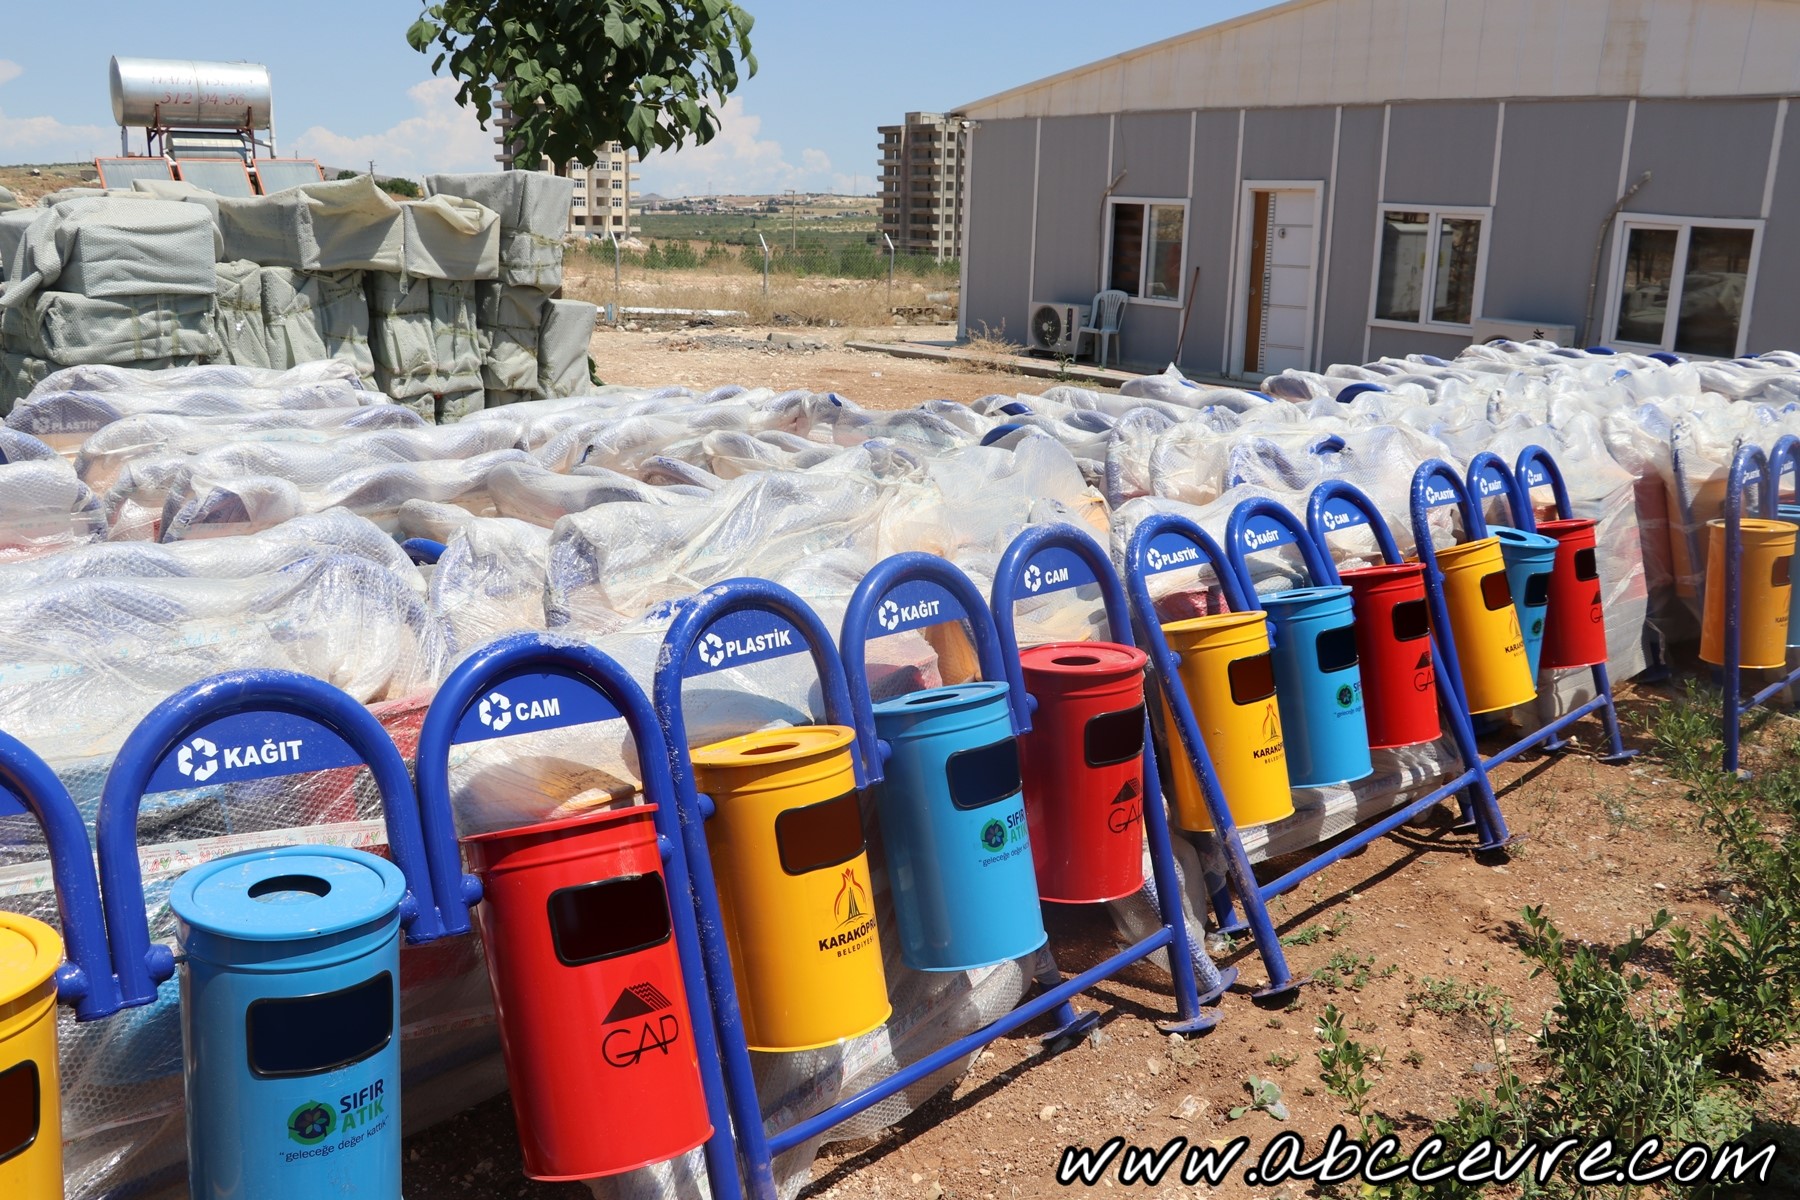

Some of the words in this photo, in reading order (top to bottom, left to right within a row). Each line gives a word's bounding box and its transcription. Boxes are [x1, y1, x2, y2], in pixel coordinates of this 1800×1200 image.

[1433, 488, 1456, 501] PLASTİK
[1334, 512, 1350, 525] CAM
[1256, 529, 1279, 545] KAĞIT
[1162, 546, 1199, 566] PLASTİK
[1045, 567, 1069, 585] CAM
[901, 600, 940, 622] KAĞIT
[726, 628, 792, 658] PLASTİK
[515, 698, 561, 721] CAM
[223, 738, 303, 769] KAĞIT
[601, 1013, 679, 1068] GAP
[340, 1078, 385, 1114] SIFIR
[341, 1095, 385, 1133] ATIK
[337, 1132, 365, 1151] değer
